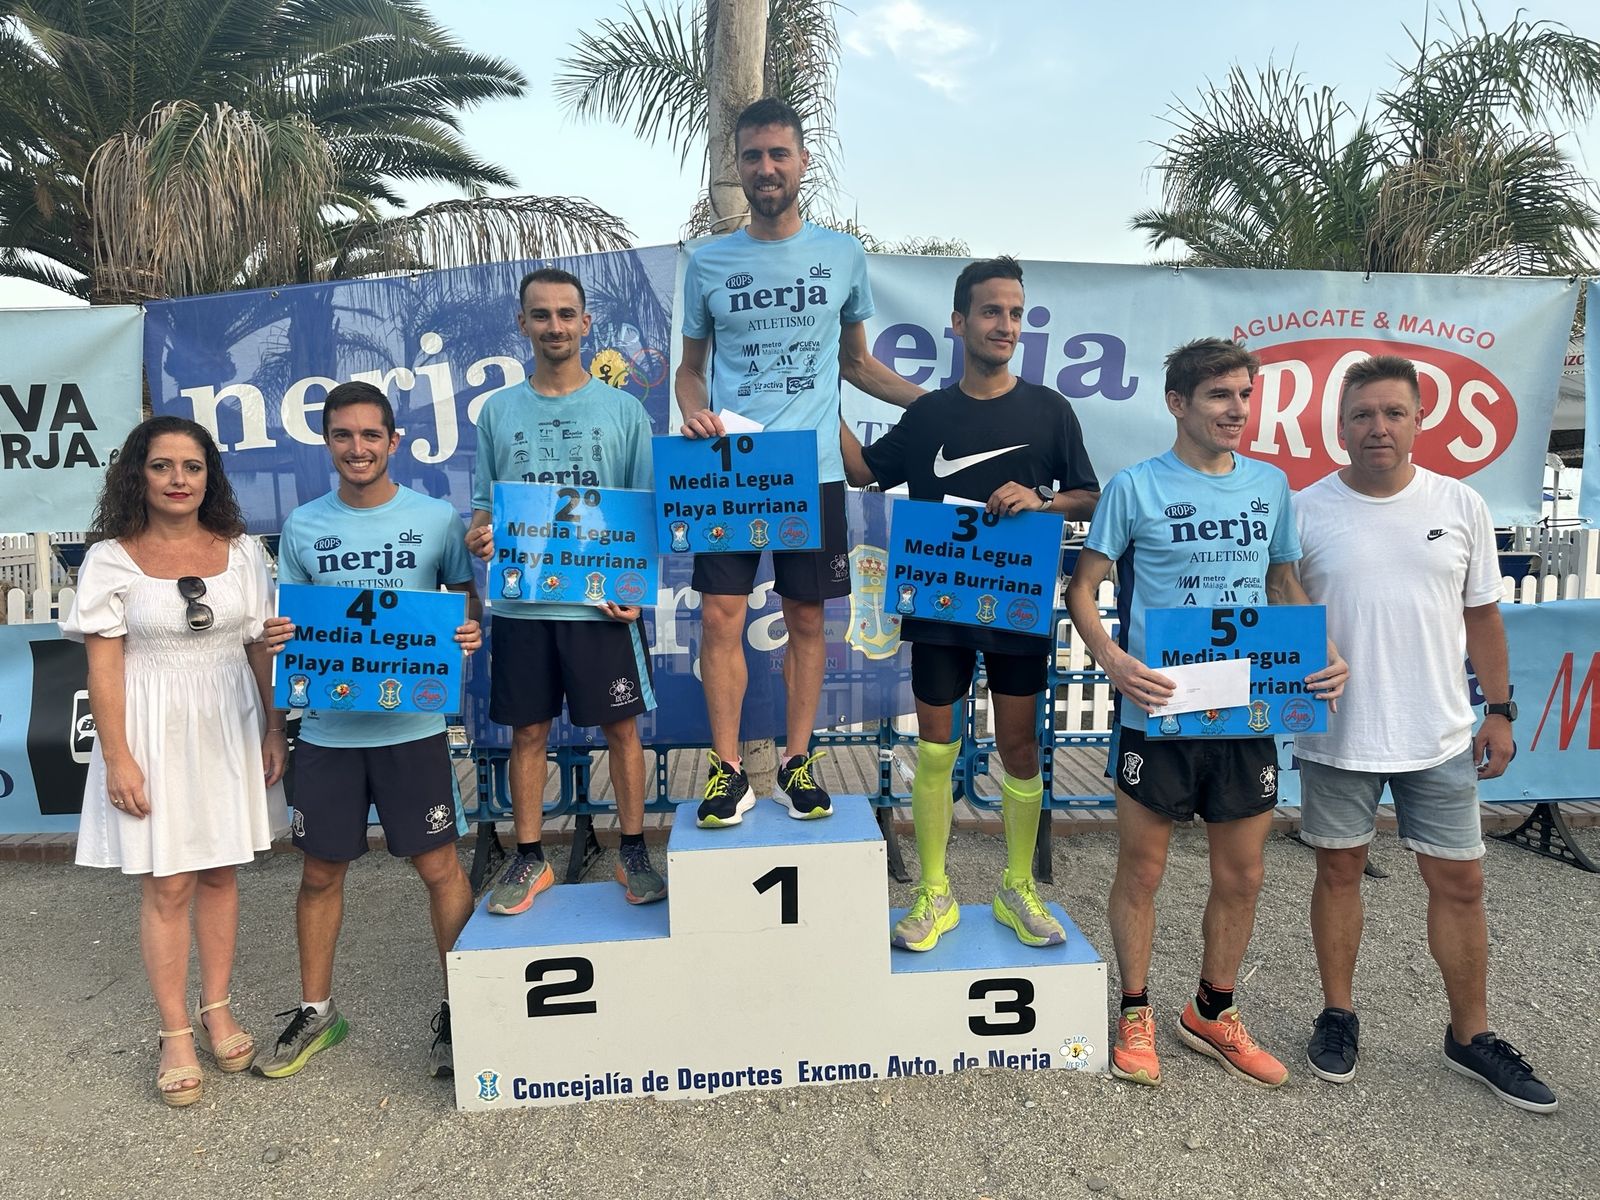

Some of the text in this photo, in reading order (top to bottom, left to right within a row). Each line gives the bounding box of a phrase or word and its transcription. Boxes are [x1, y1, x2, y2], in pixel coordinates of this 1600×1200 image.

[727, 274, 753, 289] TROPS
[729, 278, 828, 313] nerja
[748, 316, 815, 331] ATLETISMO
[1232, 310, 1495, 349] AGUACATE & MANGO
[669, 473, 794, 491] Media Legua
[664, 498, 808, 520] Playa Burriana
[1166, 504, 1196, 517] TROPS
[508, 521, 636, 545] Media Legua
[1170, 512, 1268, 546] nerja
[315, 538, 341, 550] TROPS
[905, 538, 1032, 568] Media Legua
[317, 543, 417, 575] nerja
[498, 549, 647, 570] Playa Burriana
[1190, 551, 1258, 563] ATLETISMO
[895, 565, 1042, 596] Playa Burriana
[1203, 582, 1227, 590] Málaga
[295, 627, 436, 649] Media Legua
[285, 654, 448, 676] Playa Burriana
[752, 866, 798, 924] 1
[525, 957, 597, 1017] 2
[967, 977, 1036, 1037] 3
[513, 1072, 633, 1101] Concejalía
[642, 1070, 669, 1092] de
[678, 1066, 783, 1093] Deportes
[799, 1061, 878, 1082] Excmo.
[953, 1052, 979, 1072] de
